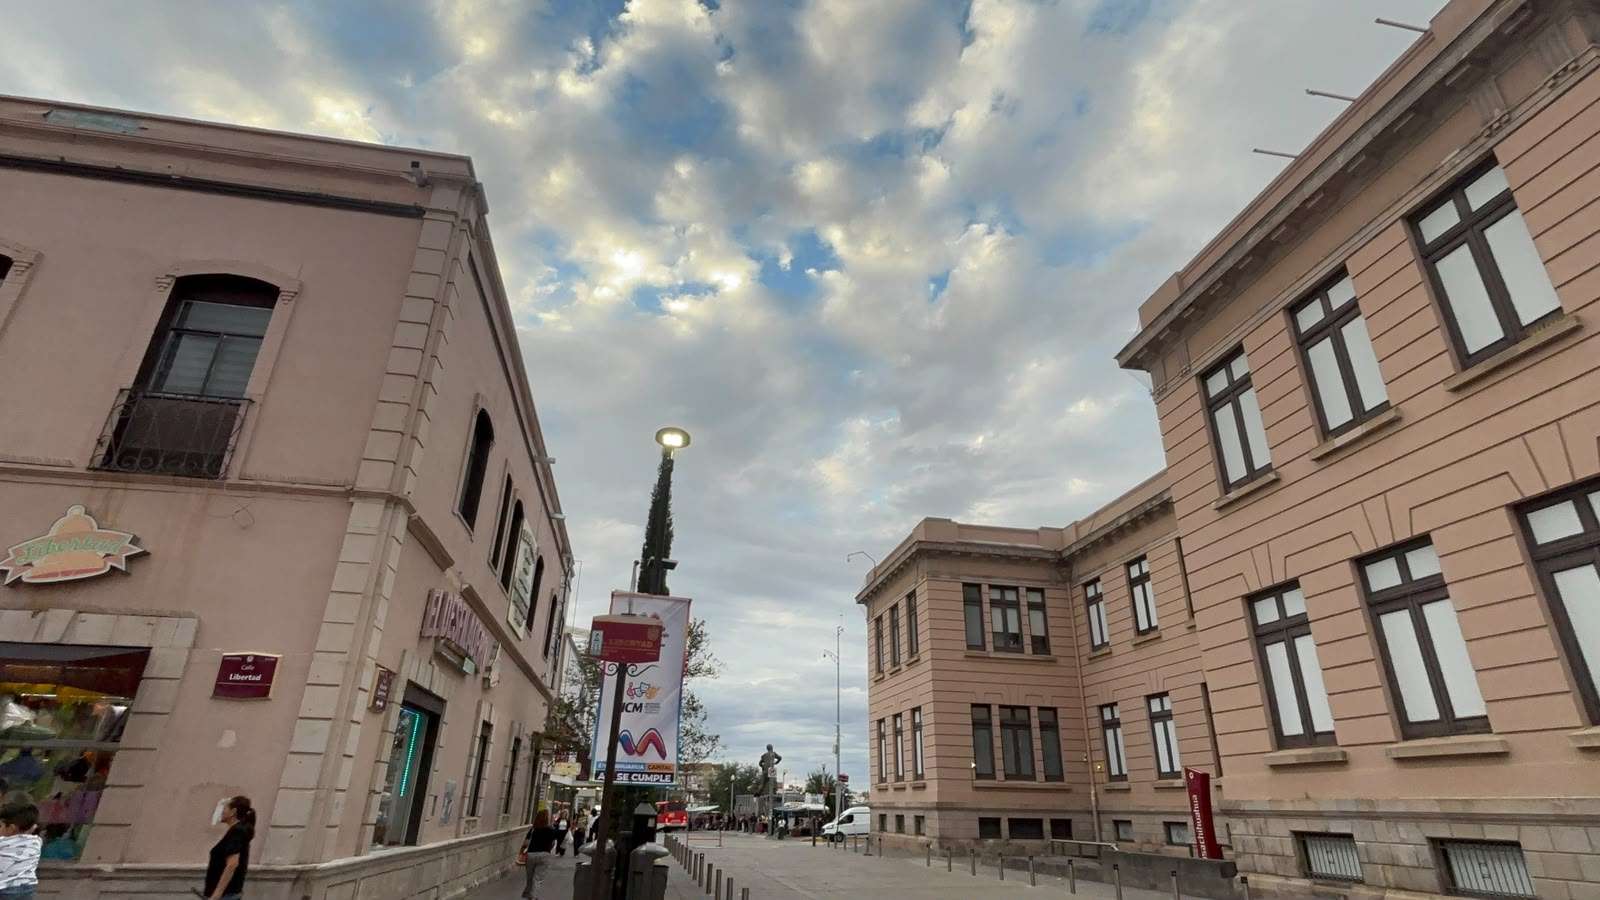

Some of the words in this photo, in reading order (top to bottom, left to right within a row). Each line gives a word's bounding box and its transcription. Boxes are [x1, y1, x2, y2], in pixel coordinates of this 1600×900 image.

[229, 673, 262, 681] Libertad
[616, 773, 629, 781] SE
[631, 773, 671, 783] CUMPLE
